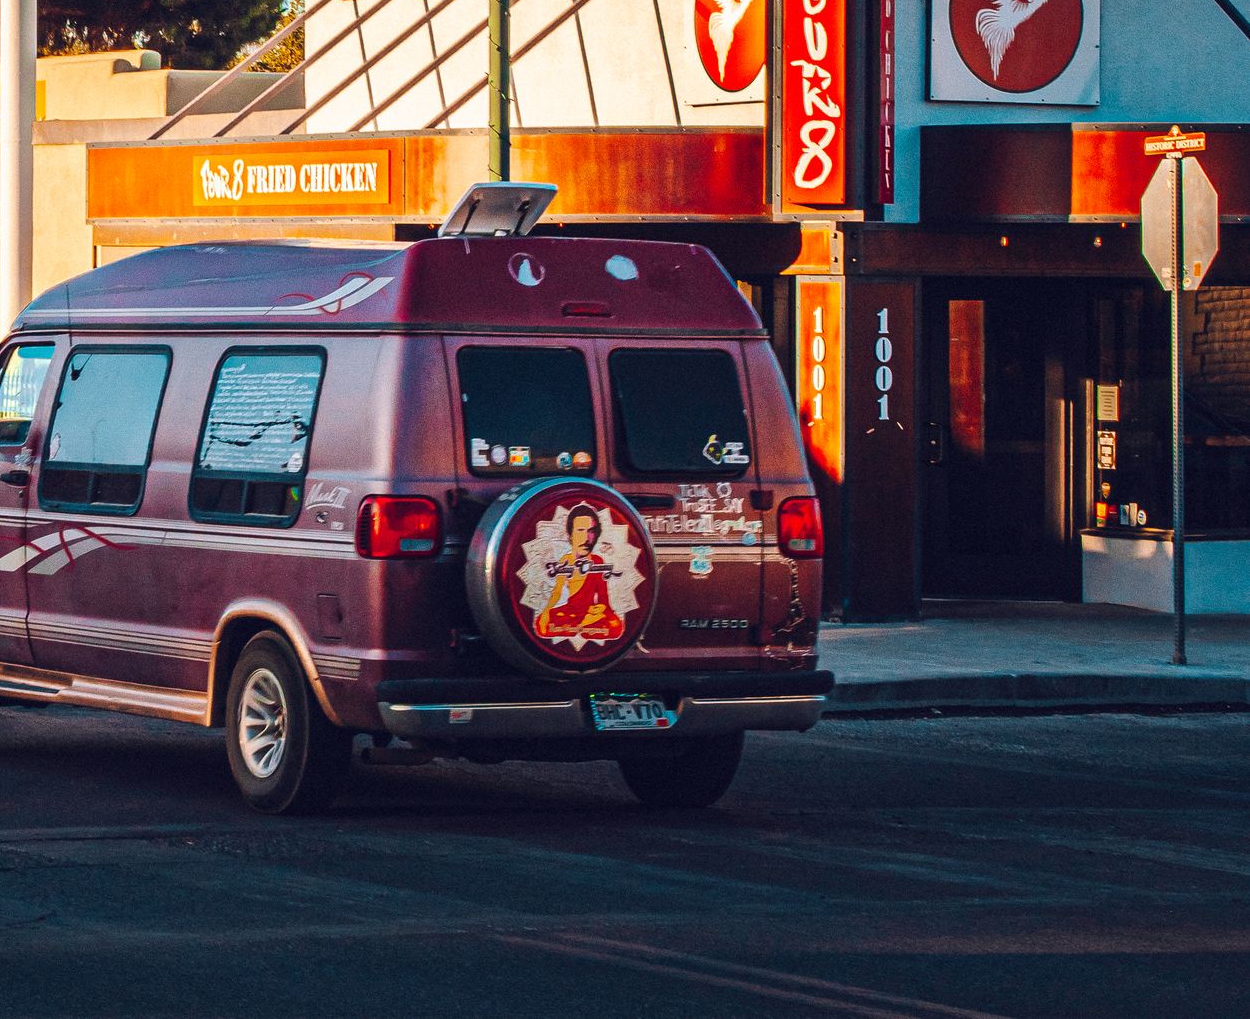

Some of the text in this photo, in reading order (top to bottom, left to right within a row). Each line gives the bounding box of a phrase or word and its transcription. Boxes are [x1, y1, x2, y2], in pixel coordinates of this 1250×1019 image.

[1145, 141, 1175, 151] HISTORIC
[1176, 138, 1205, 149] DISTRICT
[246, 165, 297, 194] FRIED
[299, 163, 378, 193] CHICKEN
[811, 306, 826, 421] 1001
[875, 307, 893, 421] 1001
[680, 619, 749, 629] RAM 2500
